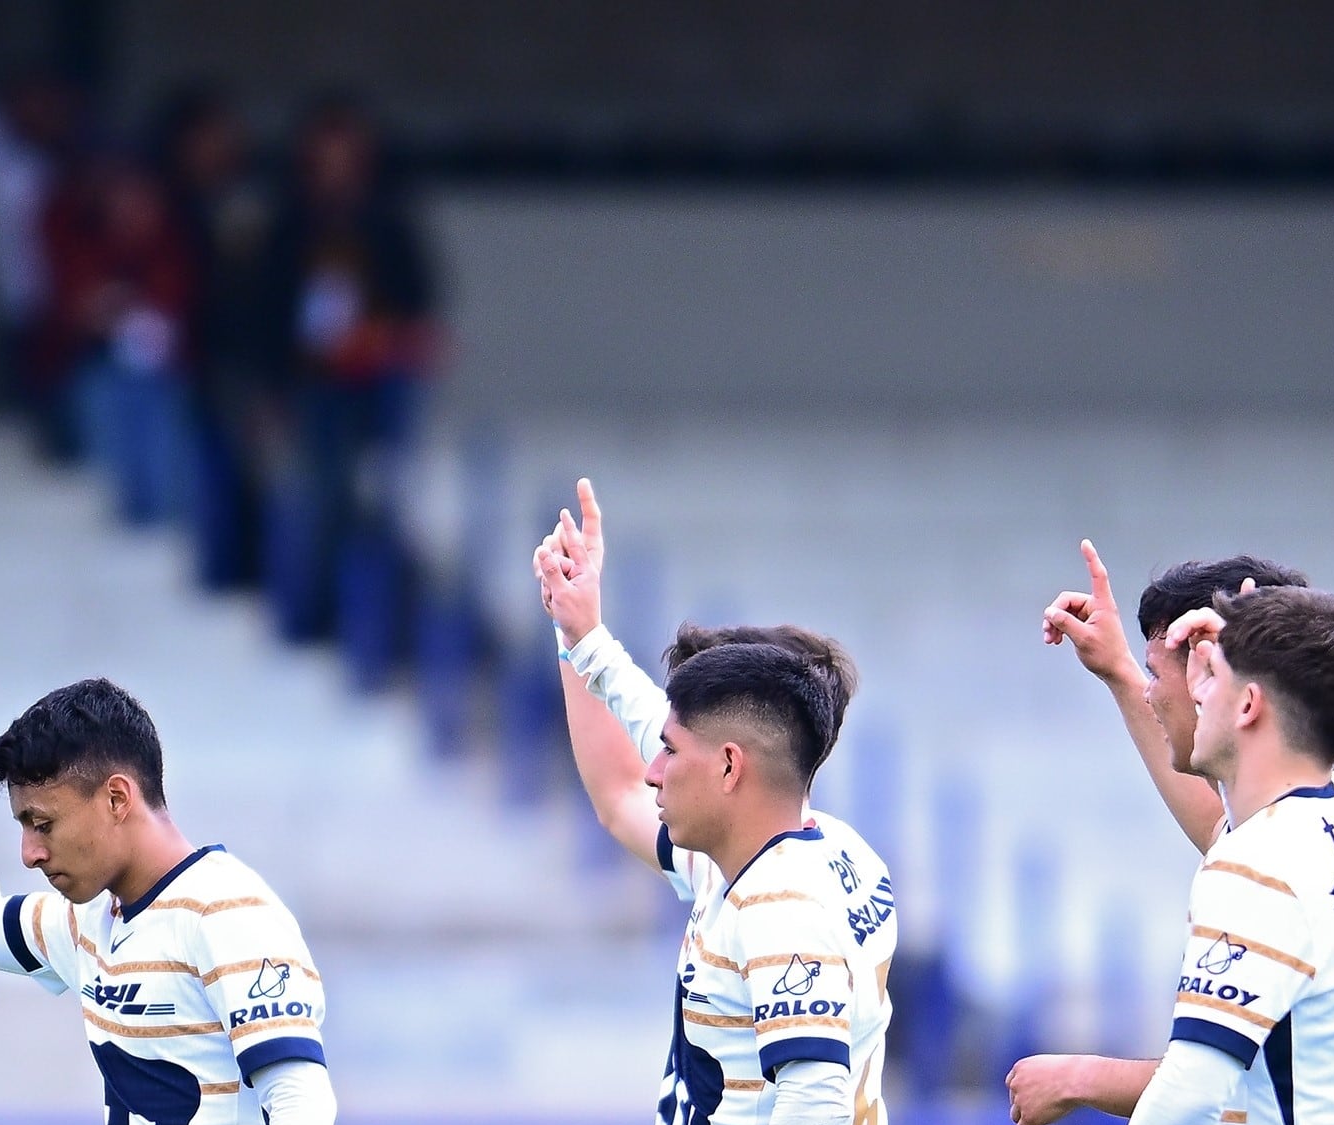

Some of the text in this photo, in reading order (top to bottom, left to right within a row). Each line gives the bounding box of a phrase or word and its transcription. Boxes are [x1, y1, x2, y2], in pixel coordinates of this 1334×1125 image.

[1177, 975, 1261, 1007] RALOY
[229, 1001, 314, 1028] RALOY
[754, 1001, 847, 1024] RALOY
